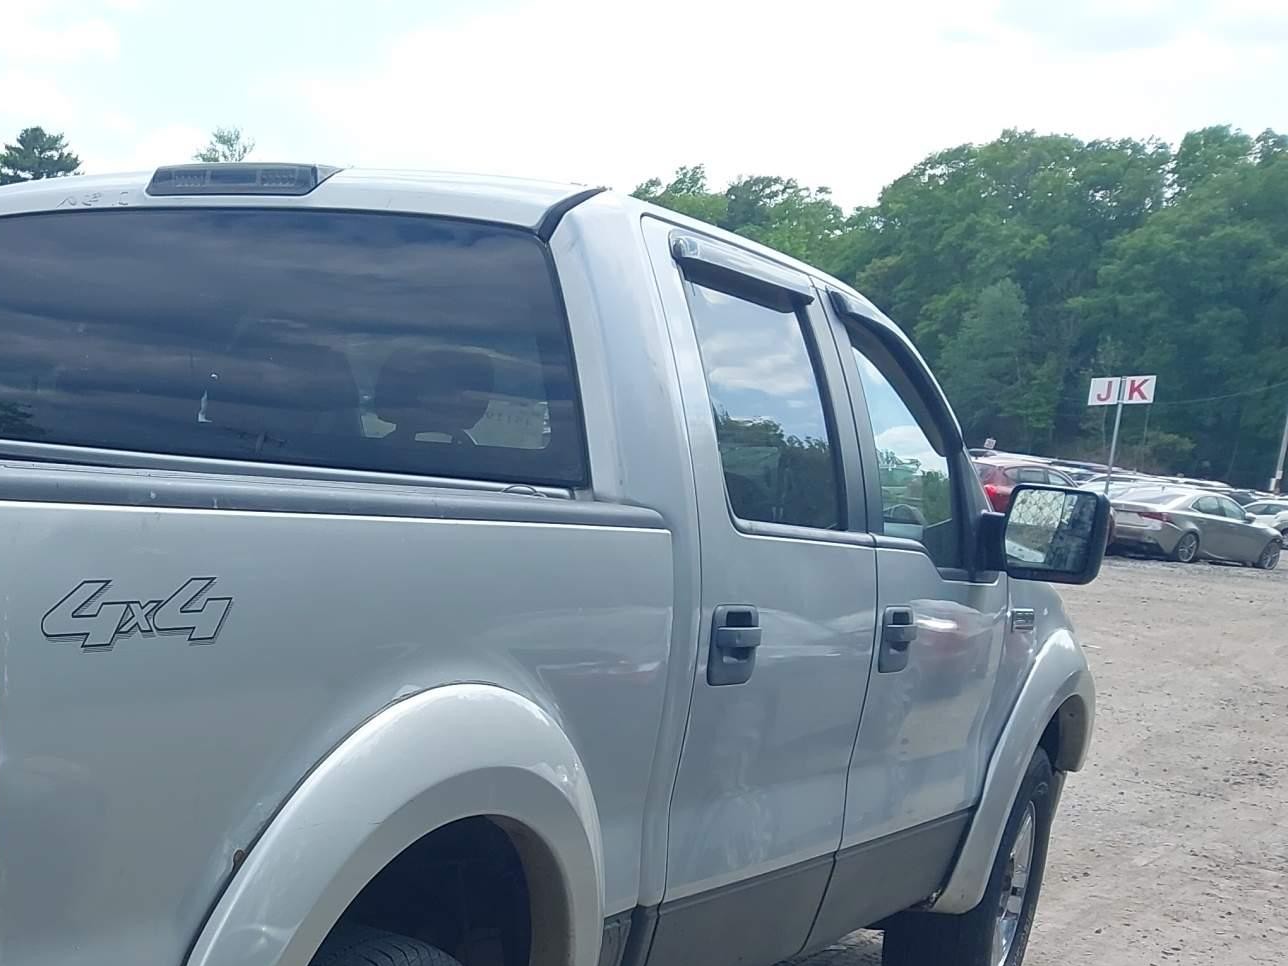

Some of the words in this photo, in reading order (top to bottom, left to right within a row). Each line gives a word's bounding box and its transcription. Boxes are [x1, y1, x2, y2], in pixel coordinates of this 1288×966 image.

[1096, 380, 1113, 402] J
[1127, 378, 1150, 401] K
[40, 576, 234, 654] 4x4
